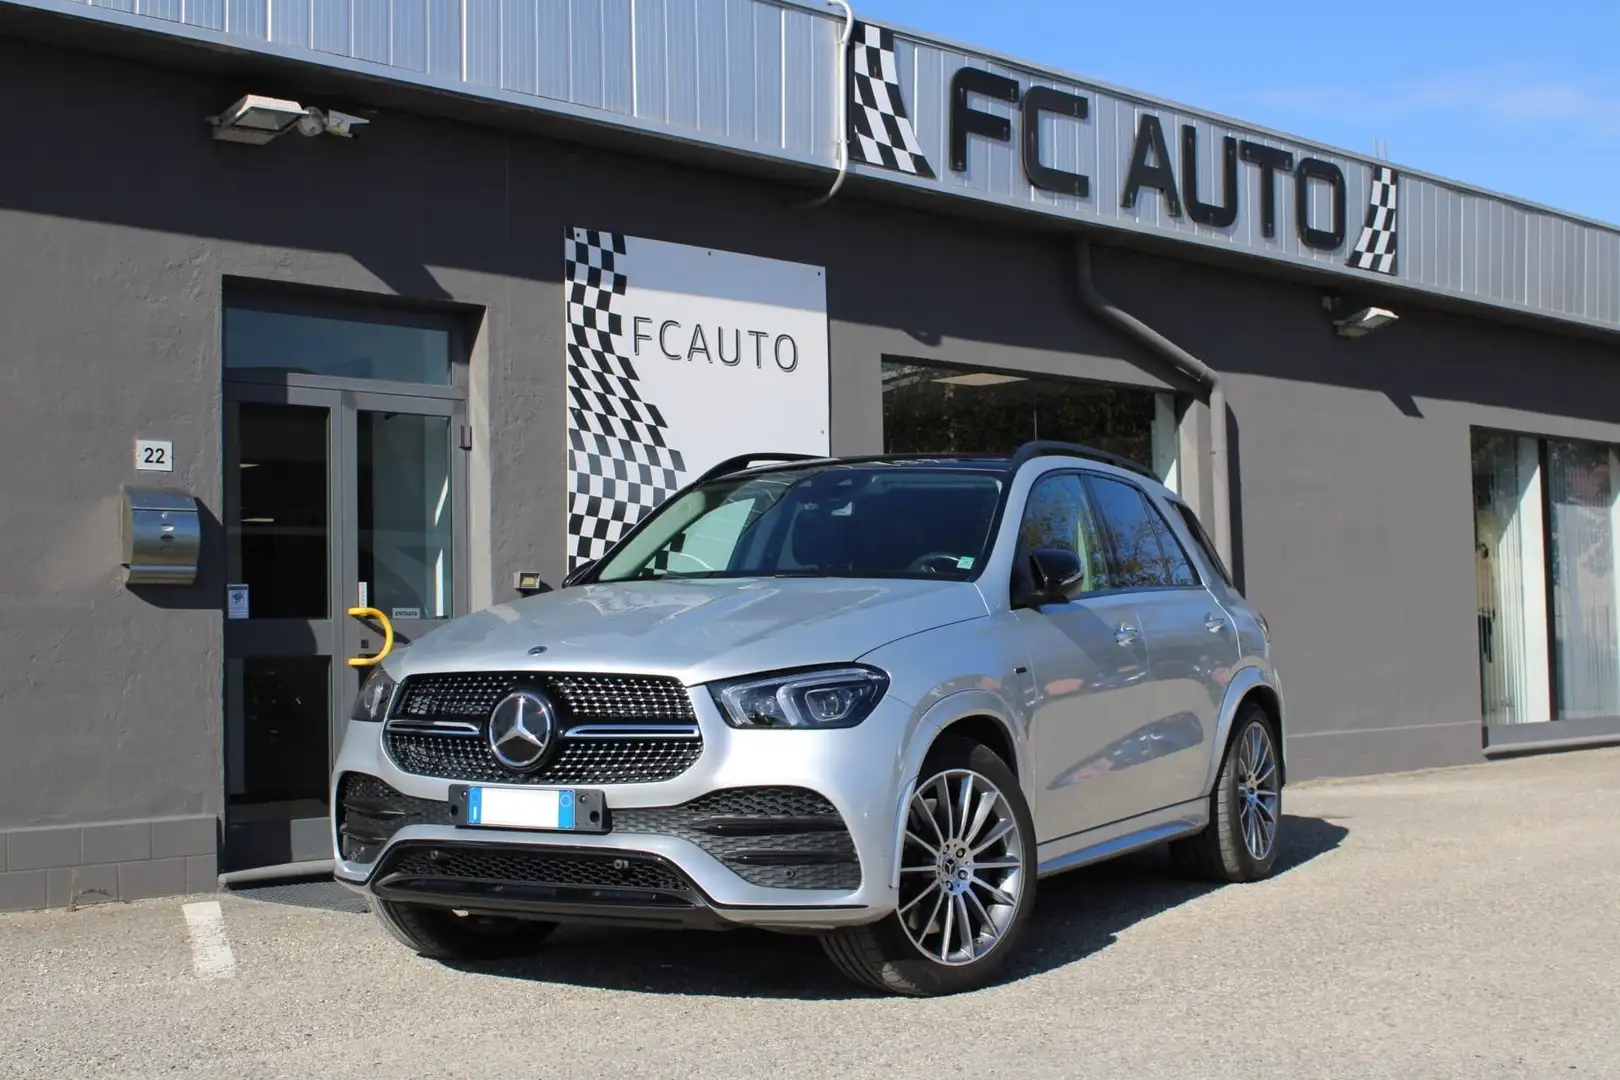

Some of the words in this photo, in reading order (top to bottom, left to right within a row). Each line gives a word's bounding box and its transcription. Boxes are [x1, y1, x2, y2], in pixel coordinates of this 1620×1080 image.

[949, 66, 1089, 198] FC
[1119, 112, 1347, 250] AUTO
[633, 316, 798, 373] FCAUTO
[144, 447, 165, 464] 22
